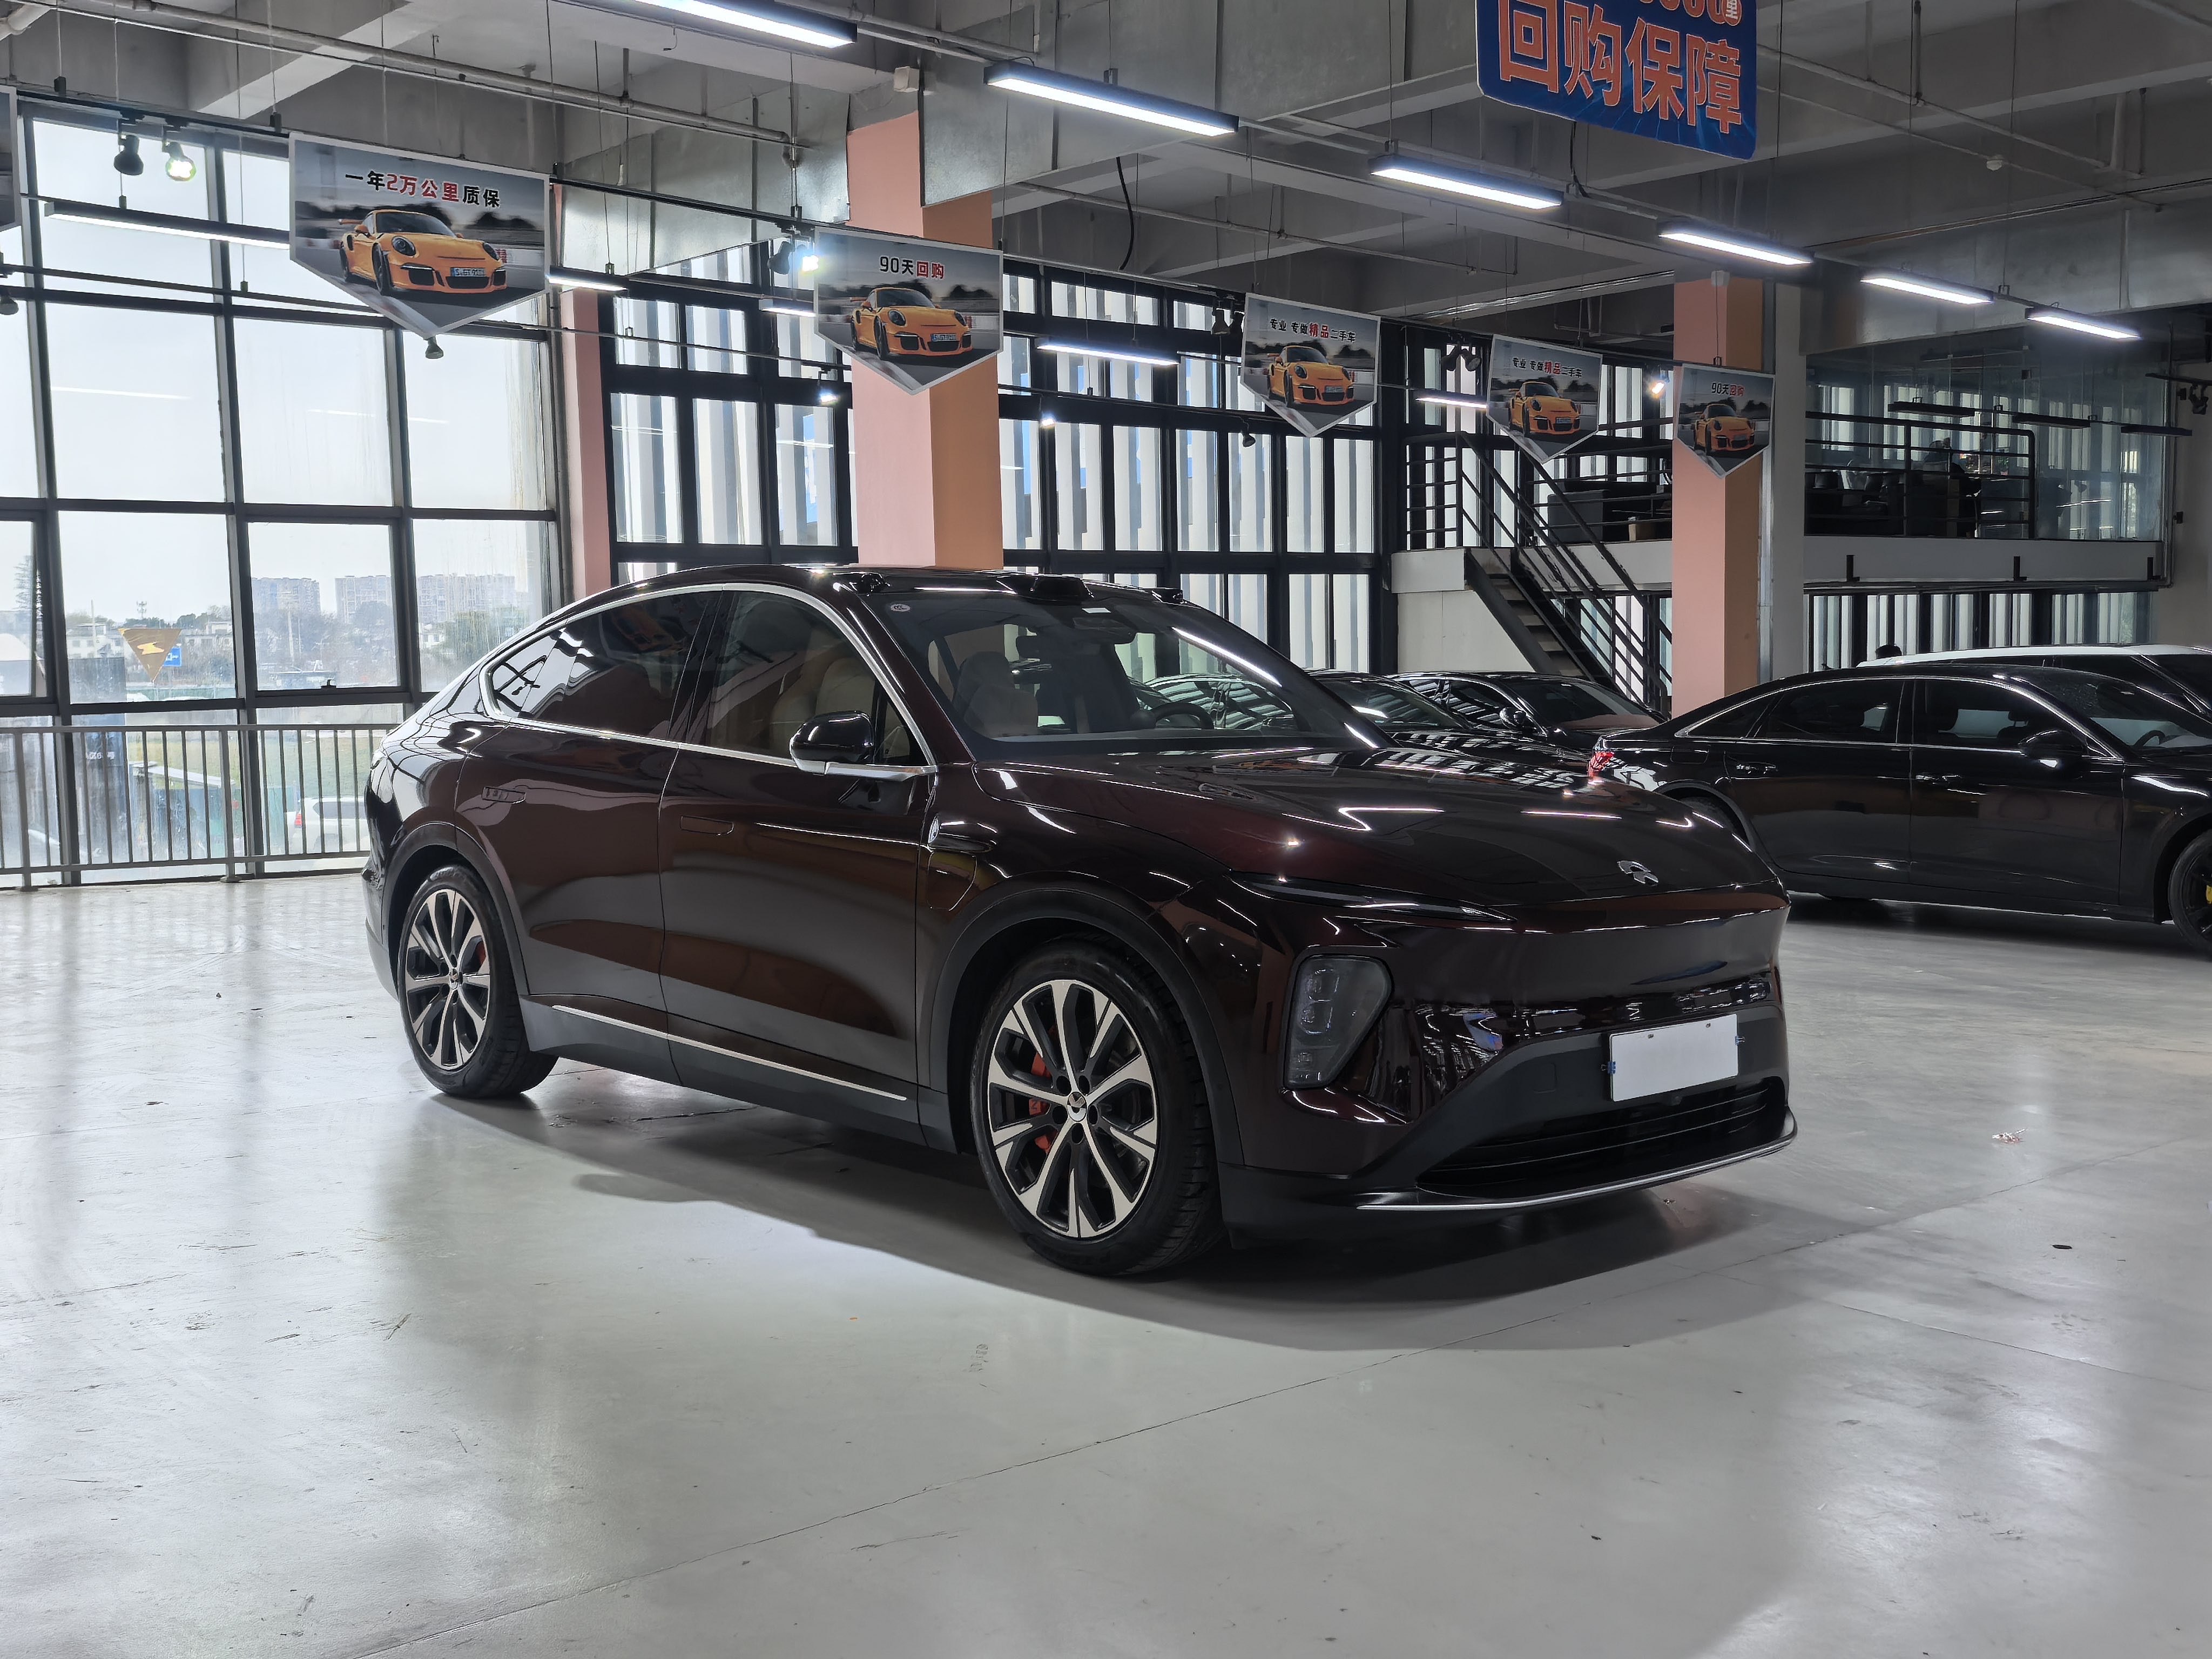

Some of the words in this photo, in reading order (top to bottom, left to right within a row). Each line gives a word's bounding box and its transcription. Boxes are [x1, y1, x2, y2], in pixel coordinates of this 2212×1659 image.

[1499, 0, 1741, 133] 回购保障
[345, 170, 500, 208] 一年2万公里质保
[880, 256, 945, 279] 90天回购
[1270, 318, 1286, 331] 专业
[1291, 322, 1355, 342] 专做精品二手车
